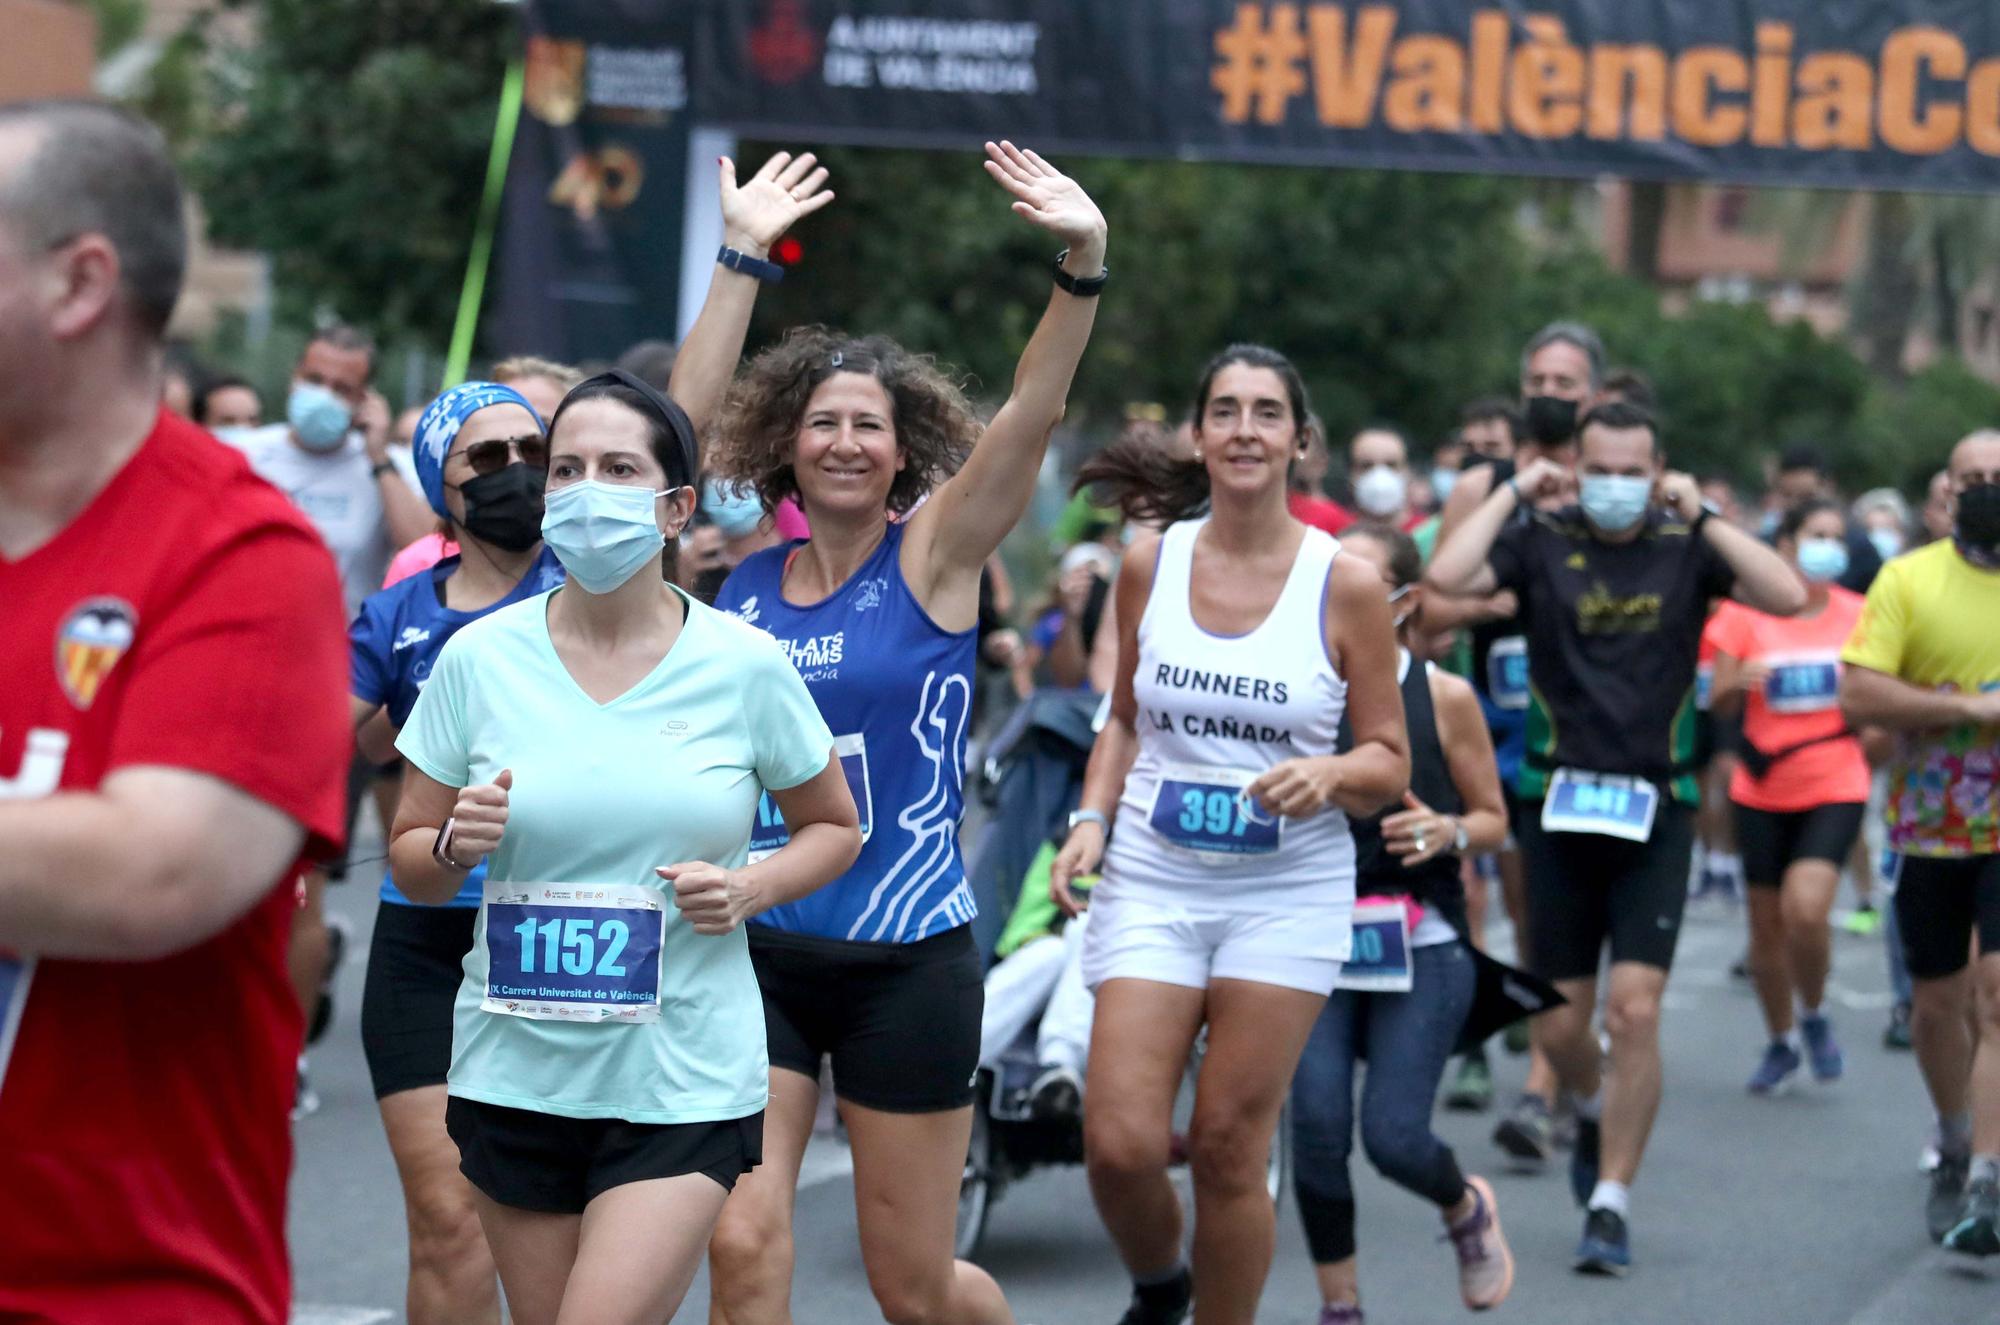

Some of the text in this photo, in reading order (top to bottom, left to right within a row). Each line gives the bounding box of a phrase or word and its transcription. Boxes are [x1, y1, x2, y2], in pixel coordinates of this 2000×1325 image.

[776, 631, 844, 655] BLATS
[1156, 664, 1288, 704] RUNNERS
[1149, 709, 1292, 746] LA CAÑADA
[1179, 788, 1253, 836] 397
[514, 917, 630, 977] 1152
[502, 985, 537, 997] Carrera
[539, 987, 592, 999] Universitat
[594, 989, 607, 999] de
[610, 990, 657, 1002] València
